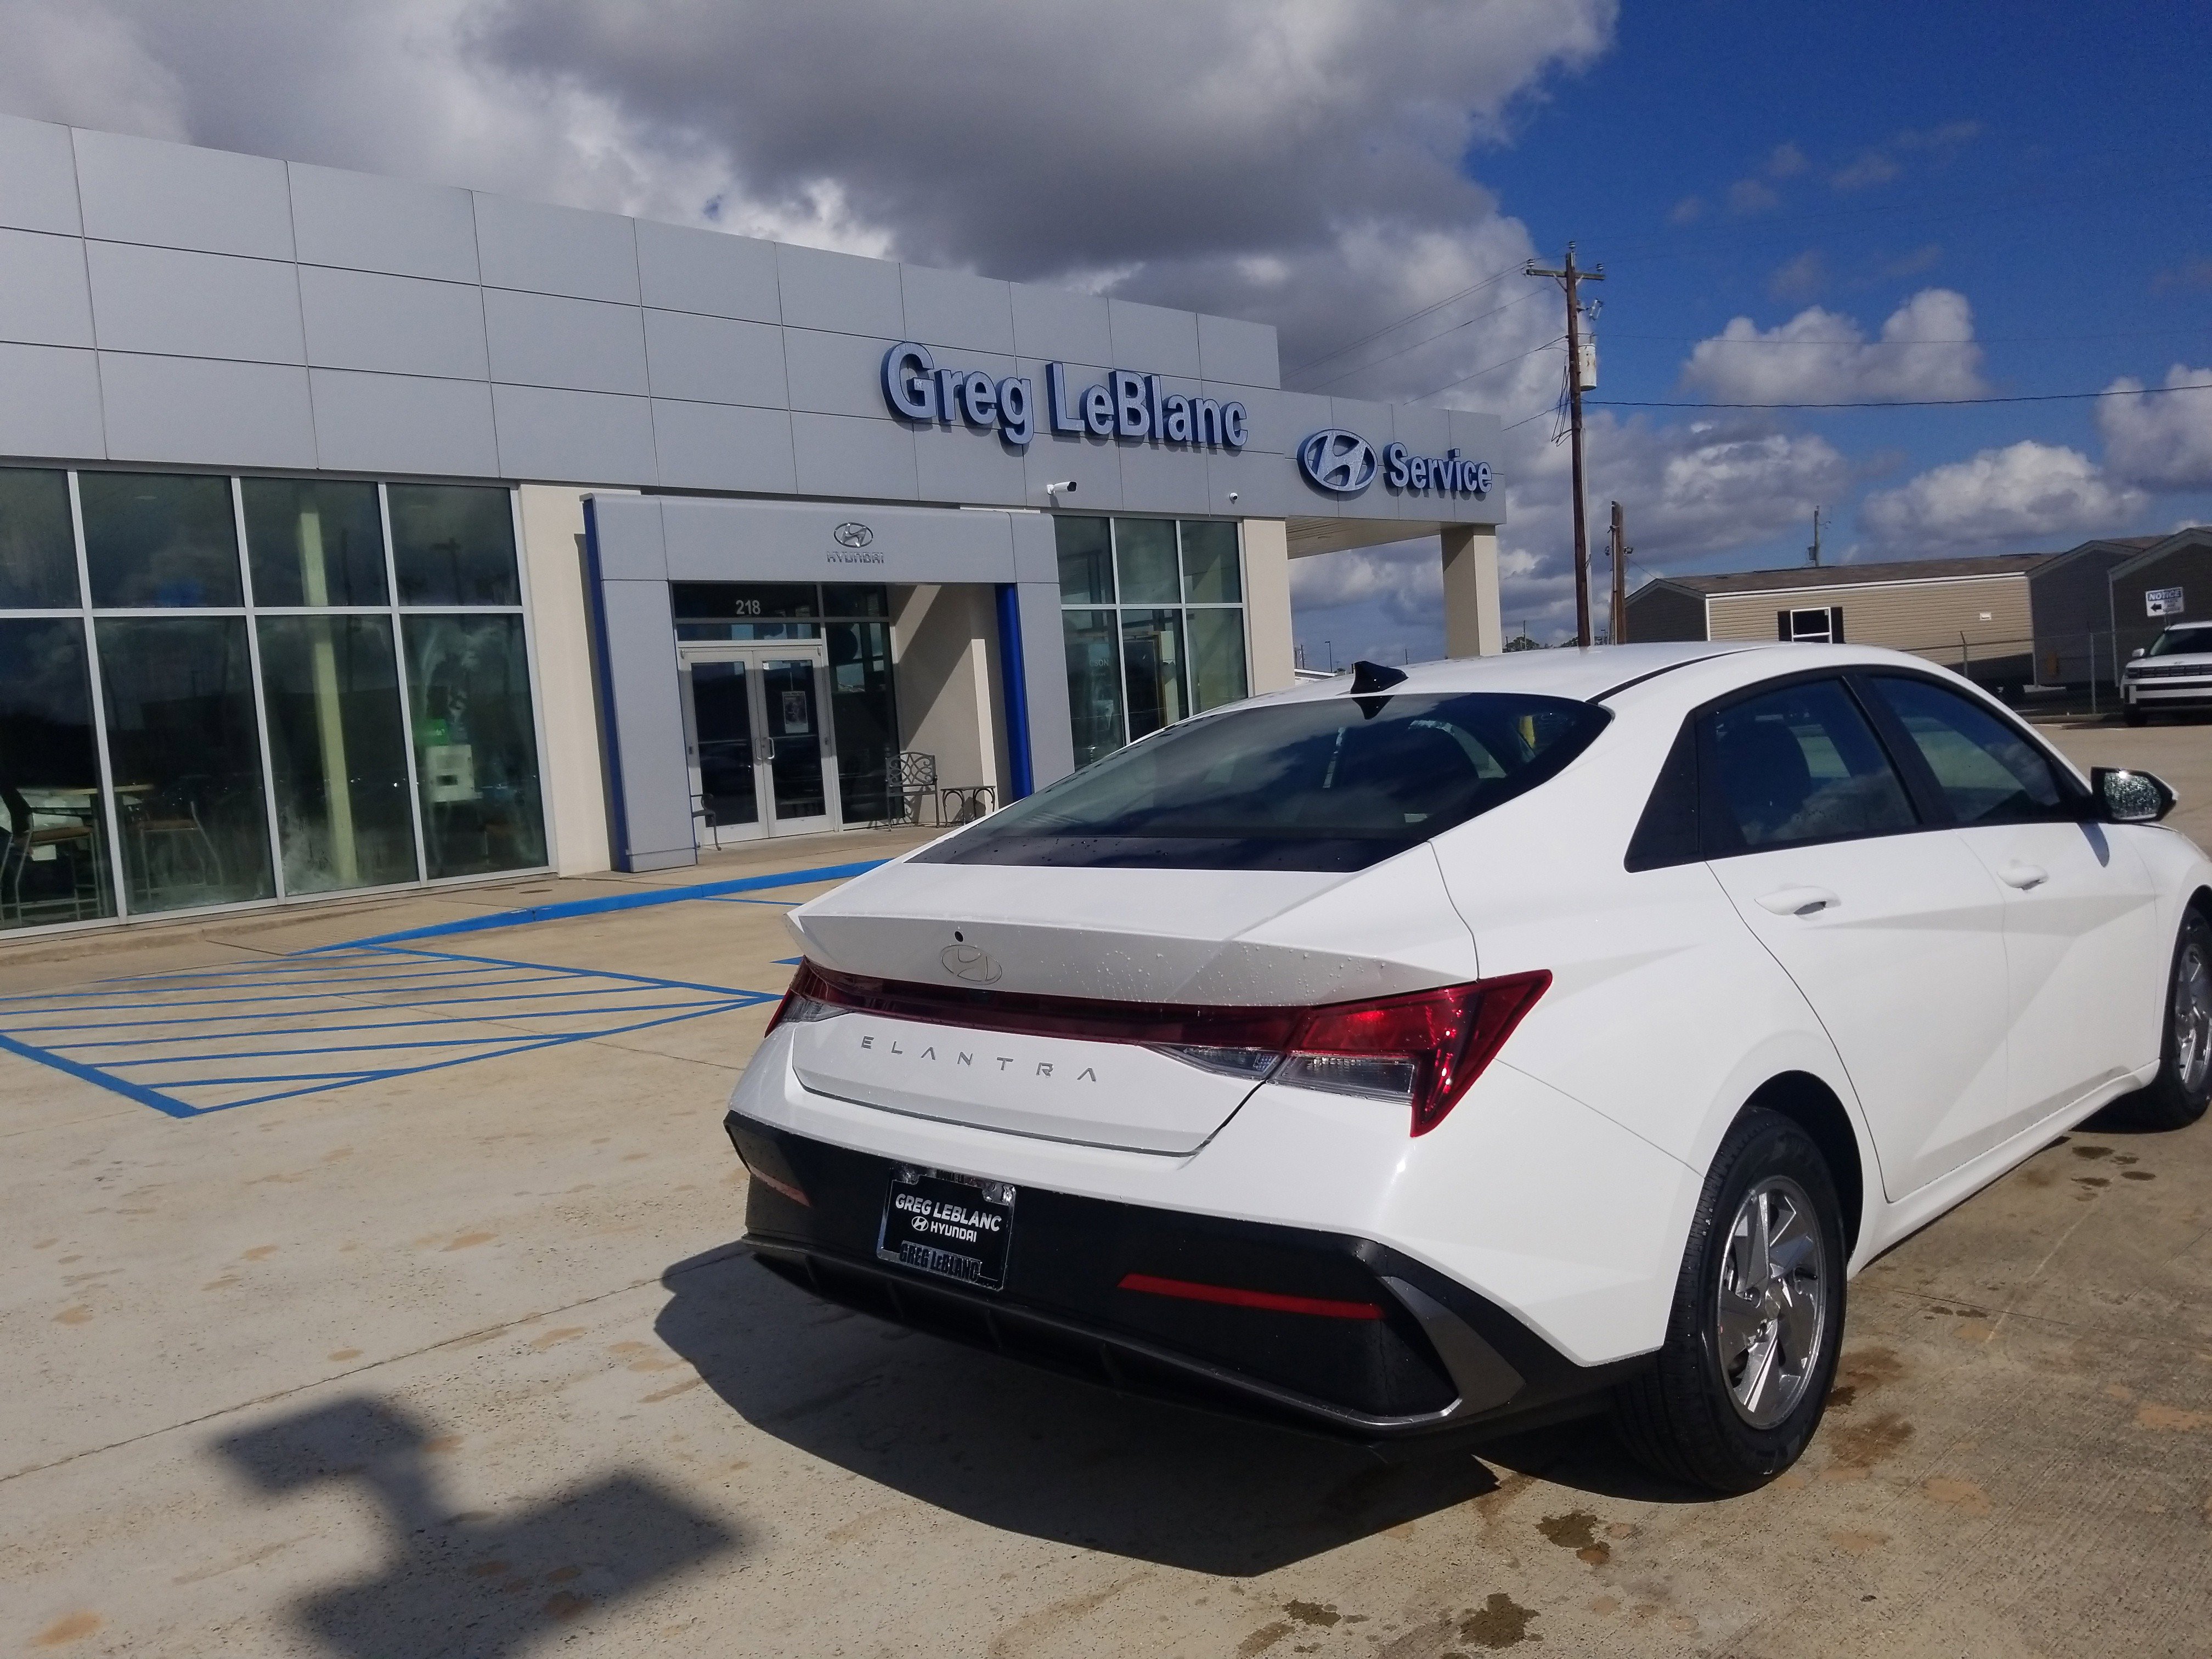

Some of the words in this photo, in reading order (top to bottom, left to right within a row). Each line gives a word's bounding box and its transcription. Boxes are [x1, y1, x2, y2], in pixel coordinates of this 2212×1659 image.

[881, 341, 1035, 445] Greg
[1046, 360, 1248, 447] LeBlanc
[1383, 442, 1493, 493] Service
[827, 551, 884, 563] HYUNDAI
[736, 600, 761, 614] 218
[2149, 589, 2181, 600] NOTICE
[861, 1036, 1097, 1083] ELANTRA
[895, 1194, 932, 1215] GREG
[933, 1202, 1002, 1232] LEBLANC
[930, 1221, 977, 1242] HYUNDAI
[900, 1243, 929, 1268] GREG
